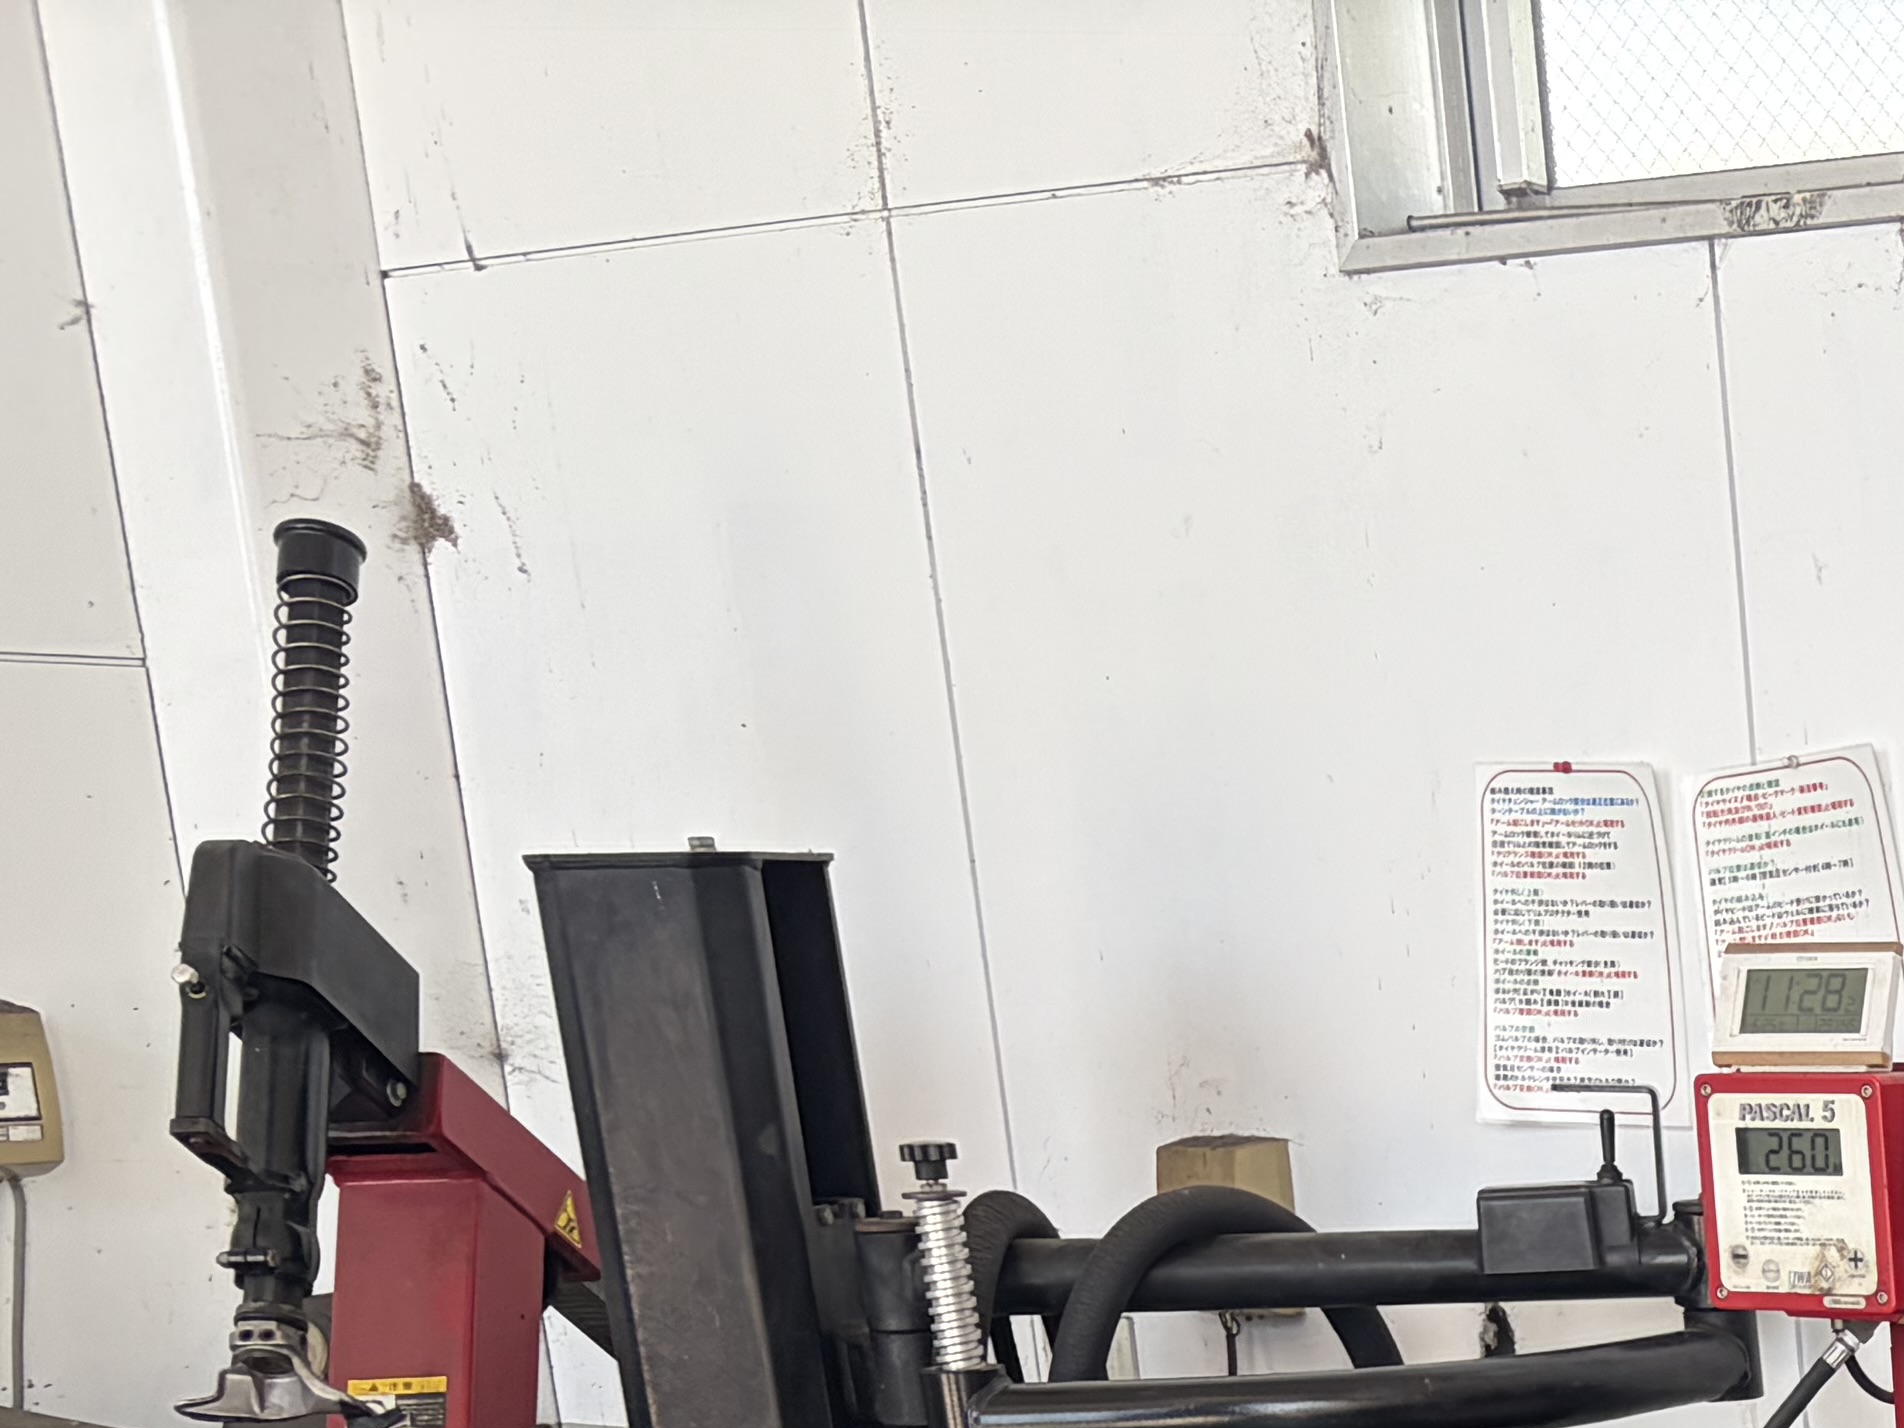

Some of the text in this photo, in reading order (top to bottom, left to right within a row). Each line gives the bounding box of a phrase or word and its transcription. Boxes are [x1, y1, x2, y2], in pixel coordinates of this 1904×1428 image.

[1739, 1100, 1836, 1123] PASCAL 5
[1765, 1131, 1830, 1172] 260
